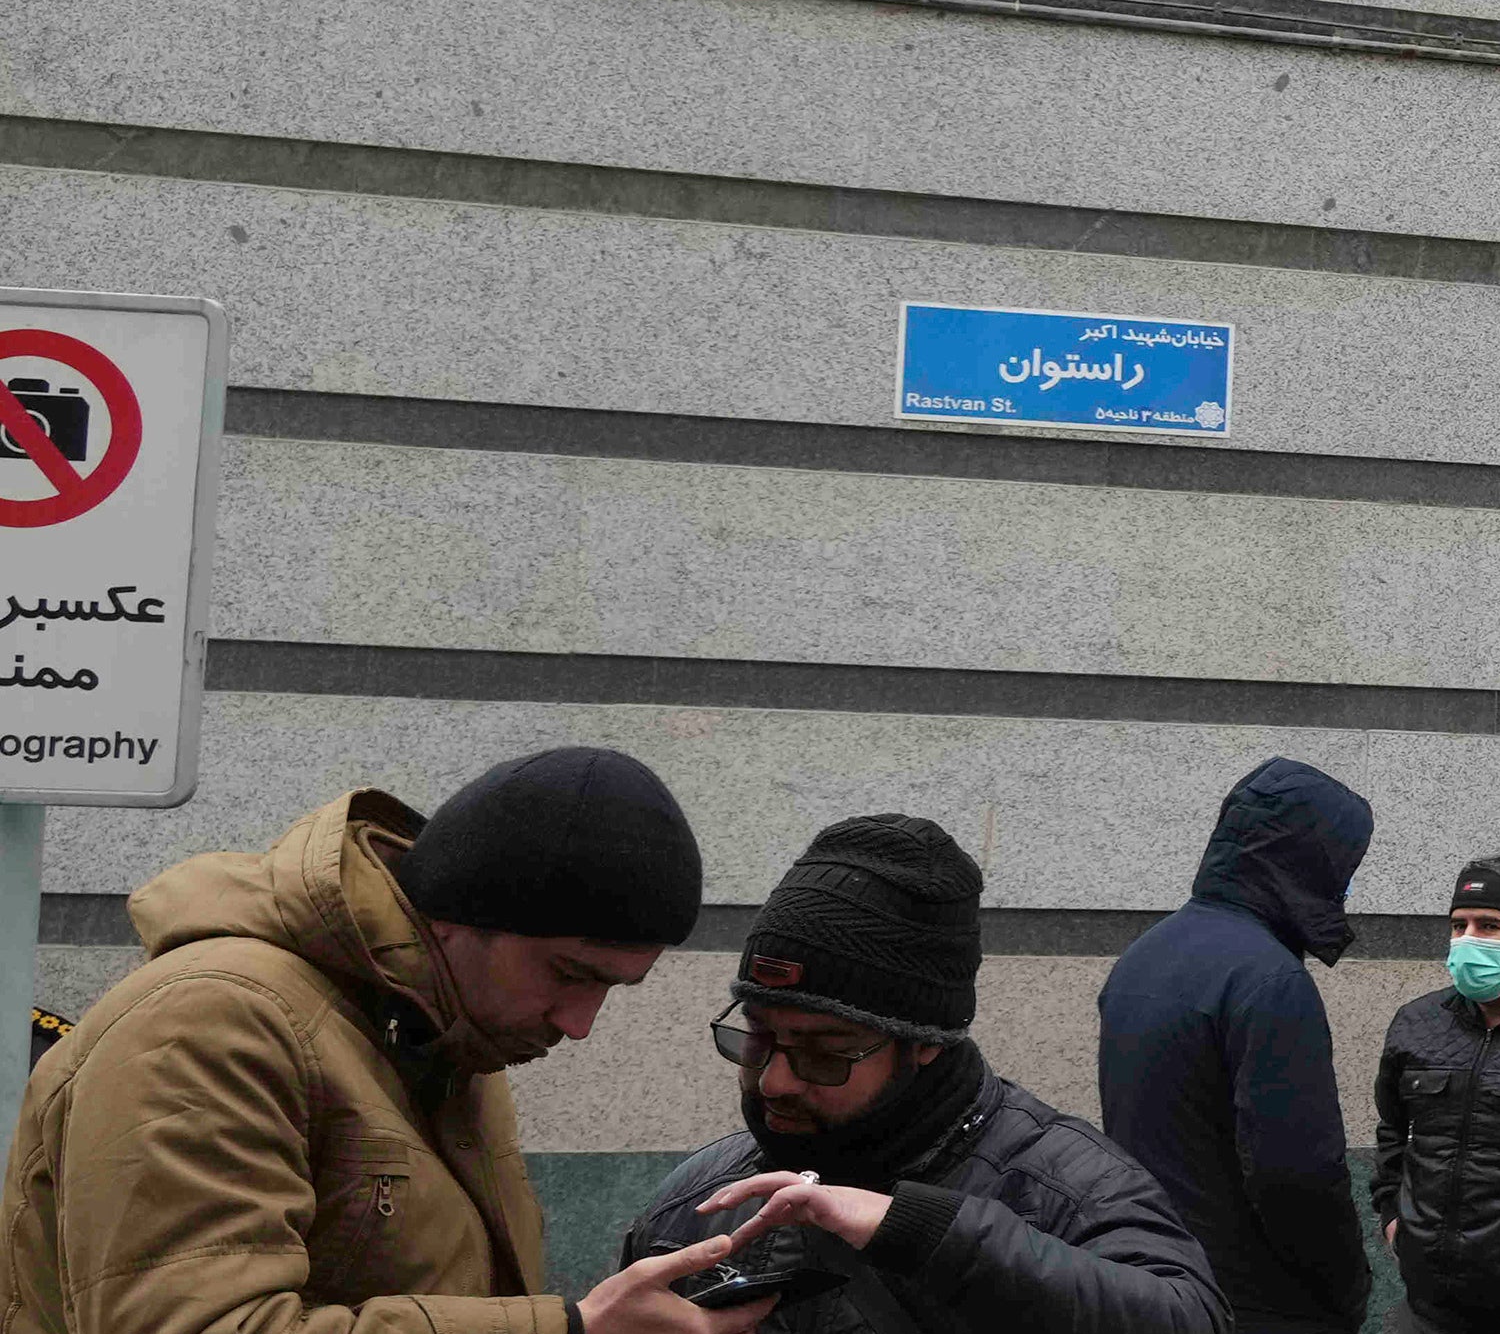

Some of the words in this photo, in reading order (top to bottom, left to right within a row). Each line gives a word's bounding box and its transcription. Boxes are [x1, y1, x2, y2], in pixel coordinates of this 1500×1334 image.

[1078, 324, 1118, 342] اکبر
[1122, 327, 1171, 347] شهید
[1172, 329, 1224, 350] خیابان
[1000, 348, 1145, 391] راستوان
[906, 392, 986, 412] Rastvan
[991, 397, 1017, 414] St.
